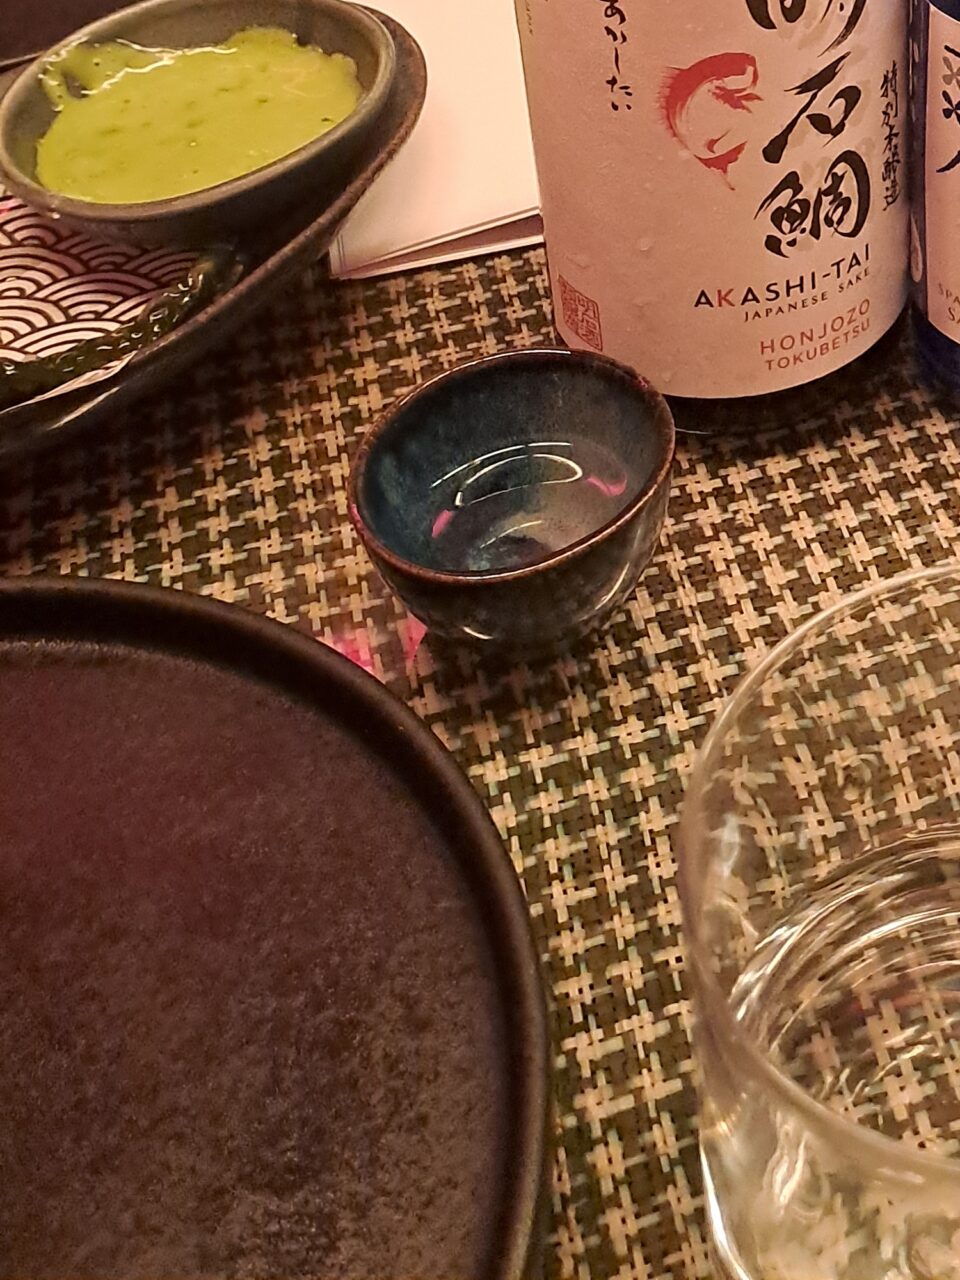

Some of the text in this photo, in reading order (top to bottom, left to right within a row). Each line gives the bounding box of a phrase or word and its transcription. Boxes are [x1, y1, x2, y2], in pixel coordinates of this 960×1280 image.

[693, 242, 871, 308] AKASHI-TAI
[743, 266, 871, 323] JAPANESE SAKE
[759, 298, 871, 356] HONJOZO
[764, 317, 871, 371] TOKUBETSU
